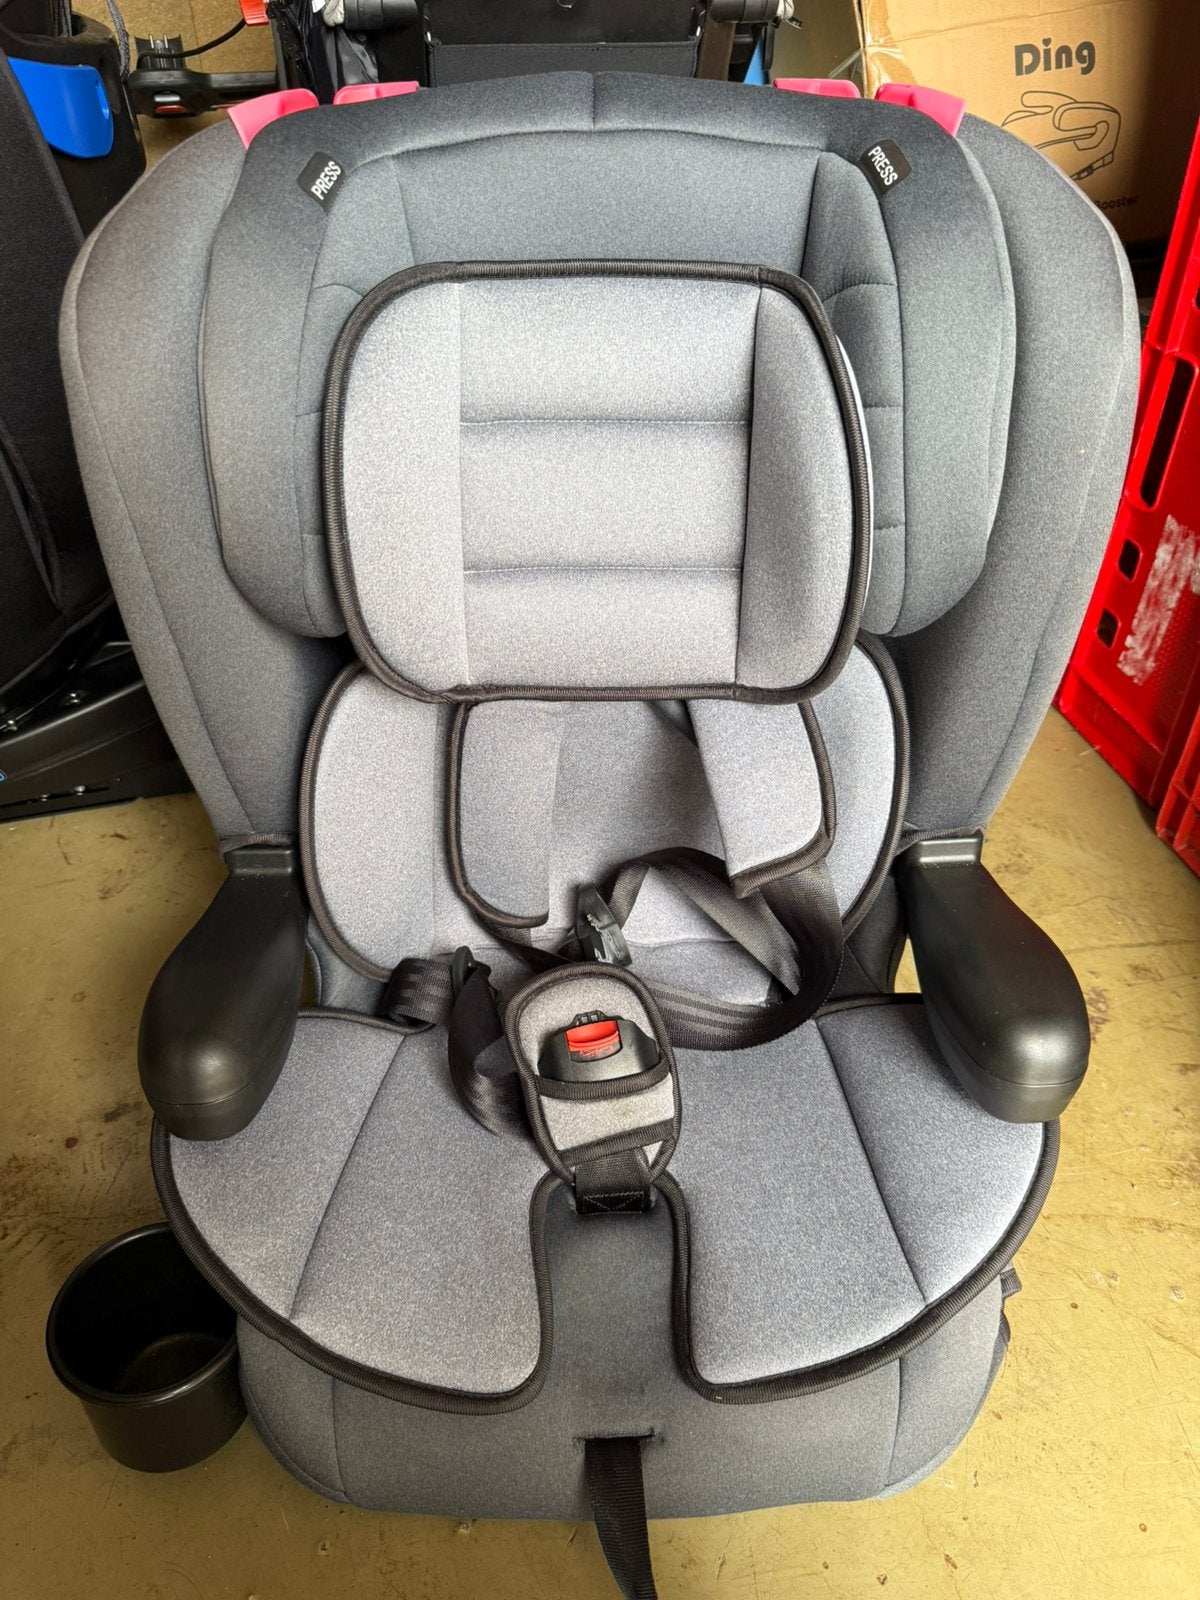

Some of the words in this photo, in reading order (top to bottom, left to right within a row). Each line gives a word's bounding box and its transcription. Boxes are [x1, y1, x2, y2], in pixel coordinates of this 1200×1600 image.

[1014, 37, 1096, 76] Ding
[311, 160, 342, 200] PRESS
[867, 146, 898, 186] PRESS
